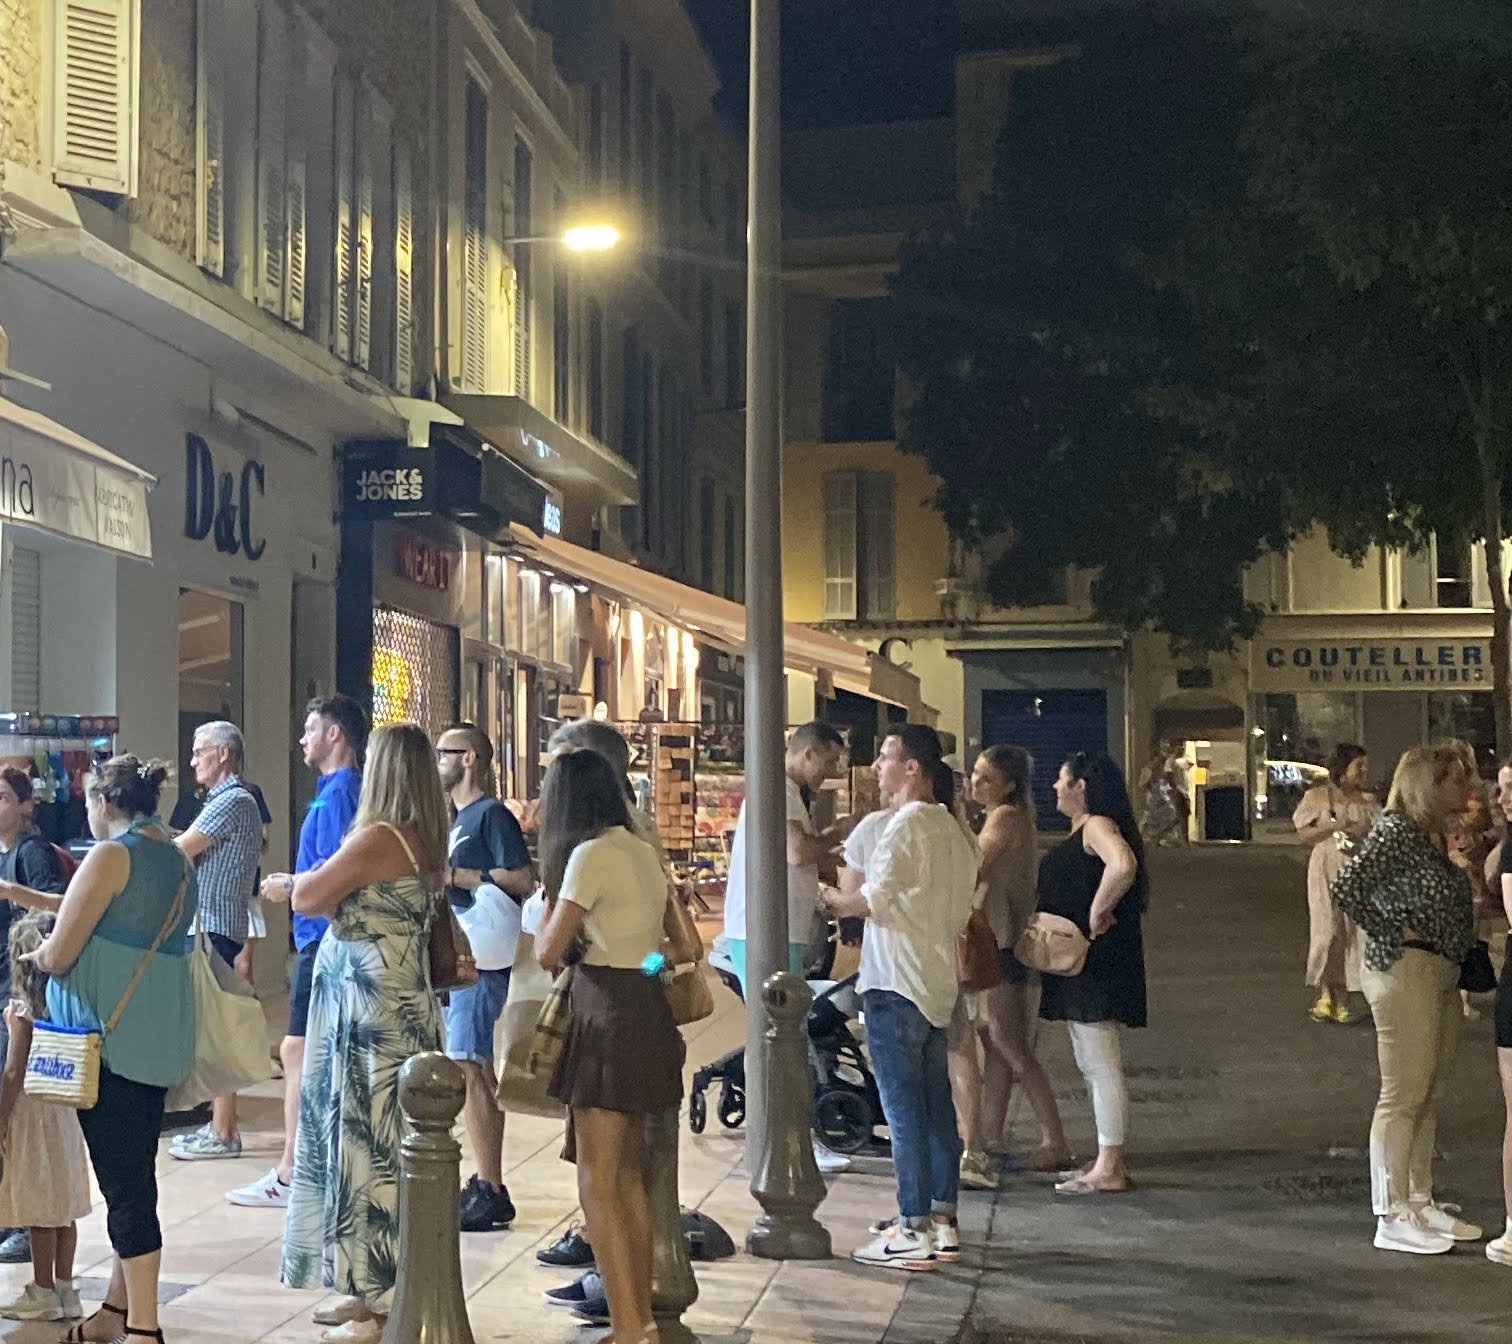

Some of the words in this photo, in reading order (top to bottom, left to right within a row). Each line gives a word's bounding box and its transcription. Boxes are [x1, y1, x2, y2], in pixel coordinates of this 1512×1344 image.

[184, 432, 266, 561] D&C
[356, 484, 423, 501] JONES
[1266, 646, 1484, 667] COUTELLER
[1402, 668, 1485, 682] ANTIBES
